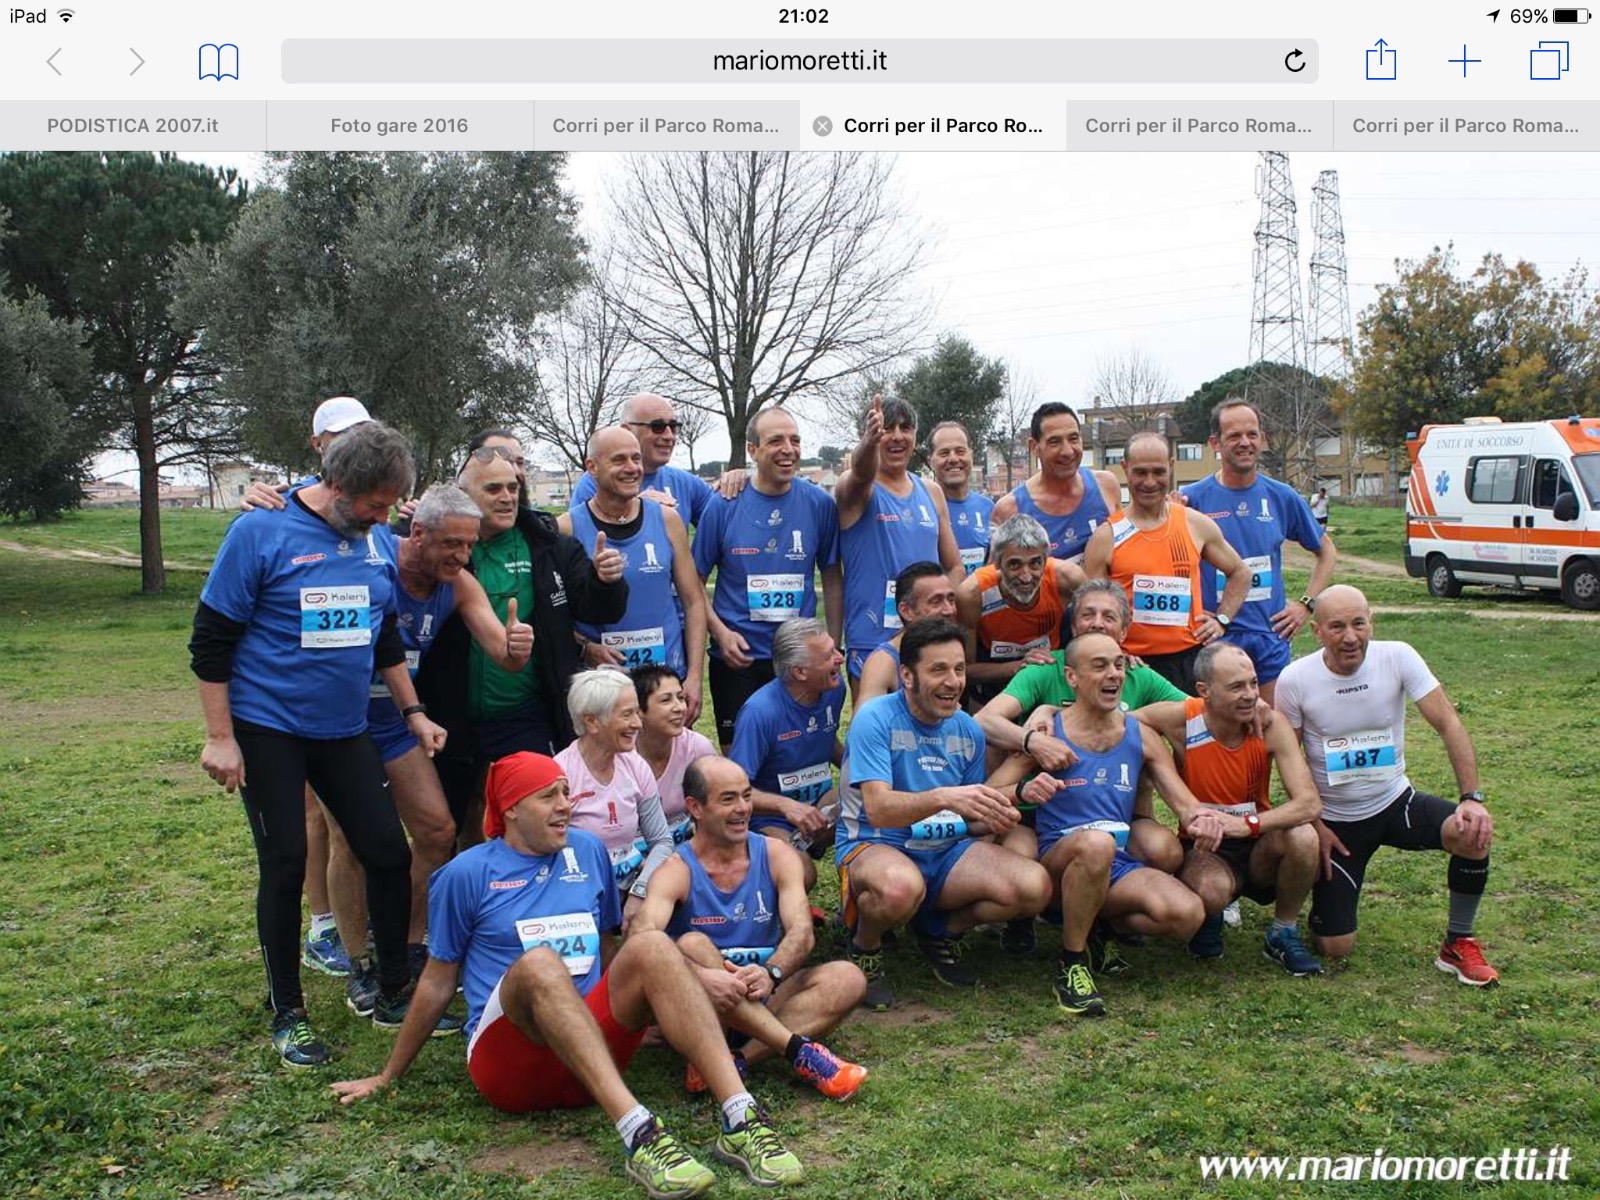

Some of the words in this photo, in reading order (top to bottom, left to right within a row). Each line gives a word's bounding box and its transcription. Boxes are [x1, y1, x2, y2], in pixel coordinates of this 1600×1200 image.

[10, 8, 46, 23] iPad
[779, 9, 829, 24] 21:02
[1511, 9, 1548, 24] 69%
[713, 49, 887, 70] mariomoretti.it
[47, 118, 149, 133] PODISTICA
[156, 118, 218, 133] 2007.it
[331, 118, 371, 133] Foto
[377, 121, 417, 137] gare
[424, 118, 468, 133] 2016
[553, 117, 598, 133] Corri
[604, 121, 634, 137] per
[640, 117, 649, 133] il
[656, 118, 707, 133] Parco
[844, 117, 889, 133] Corri
[895, 121, 925, 137] per
[931, 117, 940, 133] il
[947, 118, 998, 133] Parco
[1085, 117, 1130, 133] Corri
[1136, 121, 1166, 137] per
[1172, 117, 1181, 133] il
[1188, 118, 1239, 133] Parco
[1353, 117, 1398, 133] Corri
[1404, 121, 1434, 137] per
[1440, 117, 1449, 133] il
[1456, 118, 1507, 133] Parco
[1477, 436, 1524, 447] SOCCORSO
[760, 592, 795, 608] 328
[1144, 594, 1180, 611] 368
[317, 609, 359, 630] 322
[1341, 748, 1381, 770] 187
[923, 823, 956, 840] 318
